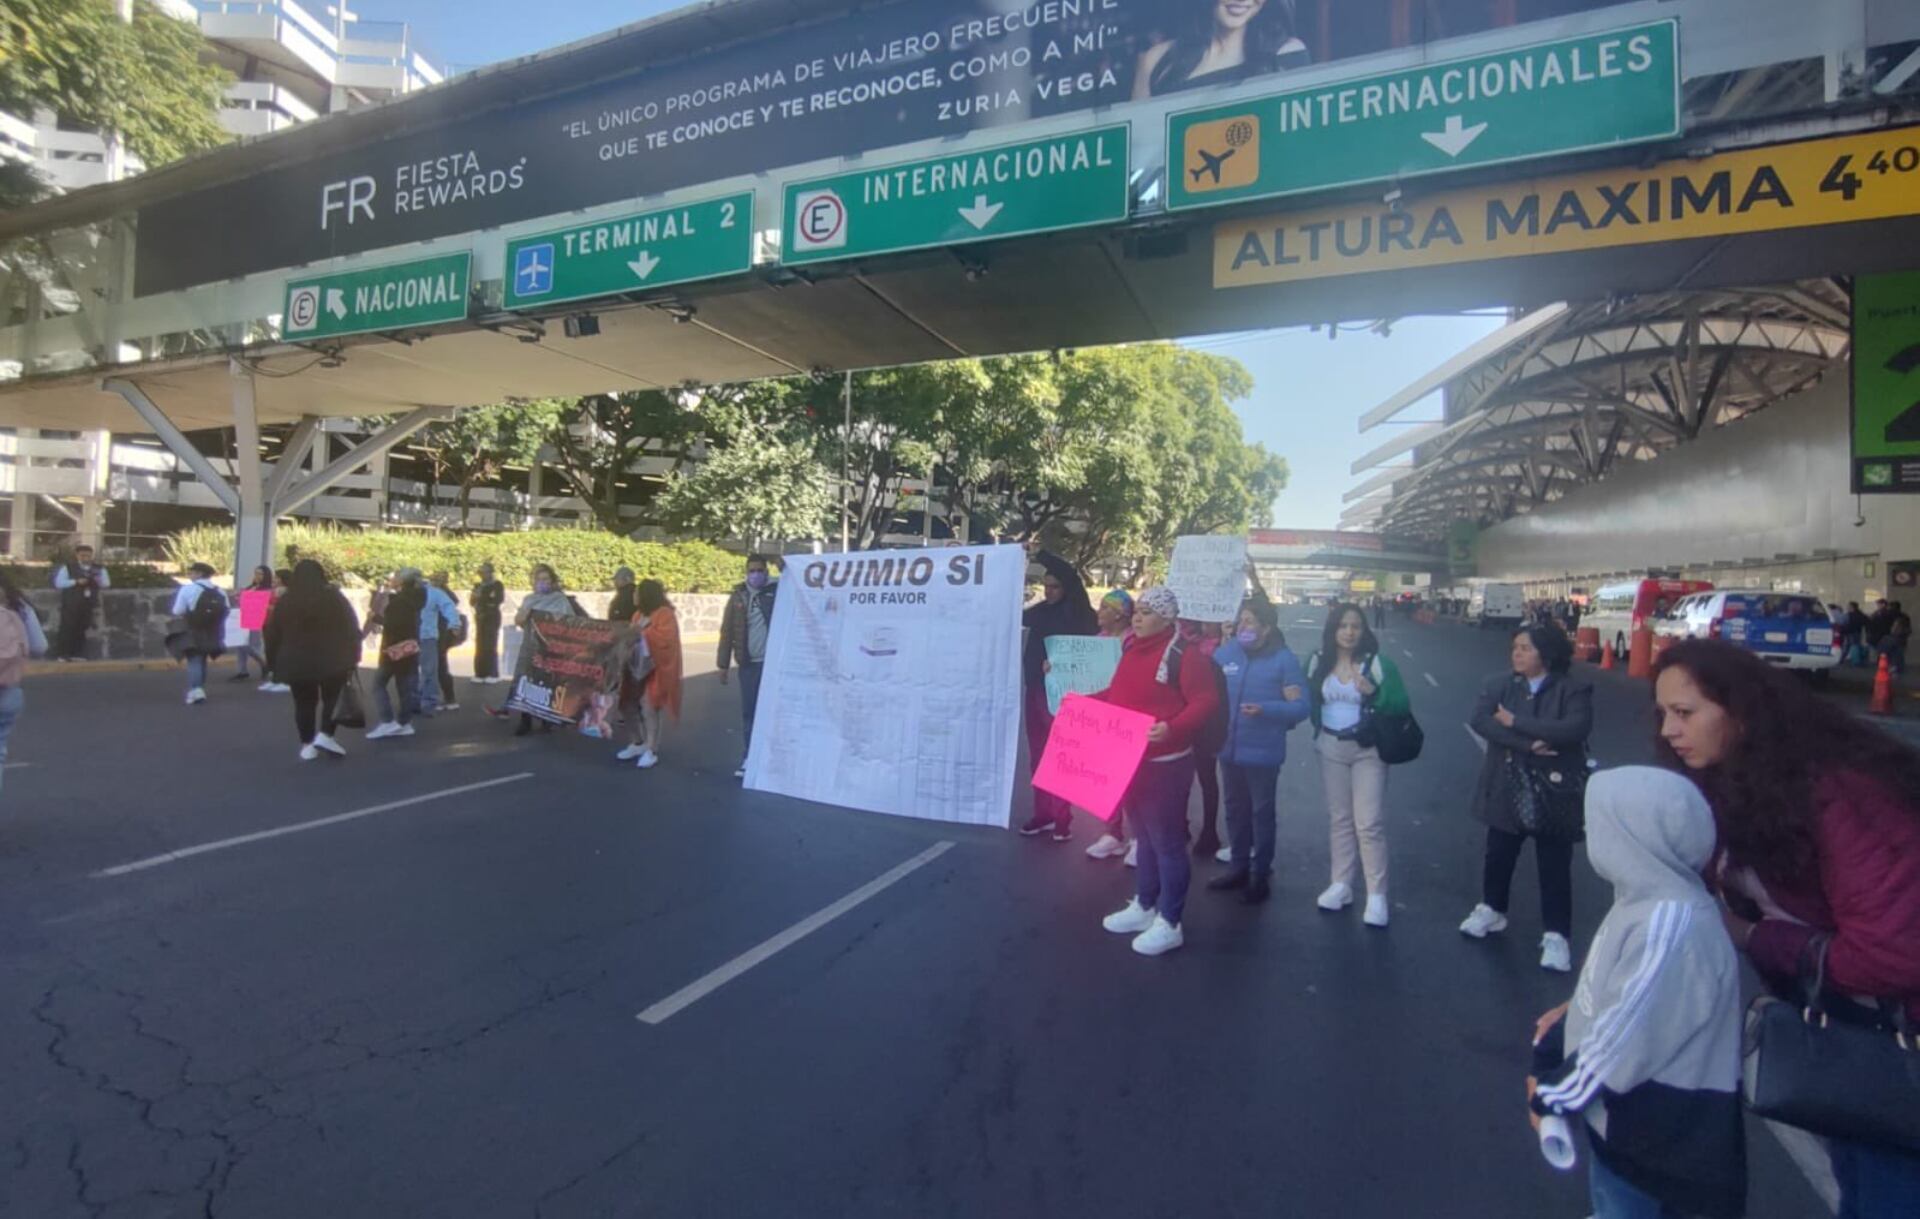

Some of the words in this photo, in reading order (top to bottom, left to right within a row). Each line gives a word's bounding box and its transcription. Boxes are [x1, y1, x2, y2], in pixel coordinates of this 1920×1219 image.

[597, 103, 659, 132] ÚNICO
[665, 70, 787, 115] PROGRAMA
[794, 58, 825, 83] DE
[833, 31, 941, 72] VIAJERO
[598, 138, 639, 161] QUE
[645, 130, 669, 151] TE
[672, 109, 755, 145] CONOCE
[760, 104, 774, 124] Y
[779, 98, 805, 119] TE
[810, 68, 942, 112] RECONOCE,
[949, 47, 1032, 82] COMO
[1042, 41, 1063, 62] A
[937, 89, 1022, 121] ZURIA
[1037, 68, 1118, 99] VEGA
[1279, 34, 1653, 134] INTERNACIONALES
[396, 150, 480, 189] FIESTA
[863, 136, 1112, 203] INTERNACIONAL
[321, 175, 377, 230] FR
[563, 210, 696, 258] TERMINAL
[720, 202, 735, 229] 2
[811, 203, 831, 235] E
[1231, 204, 1463, 271] ALTURA
[1486, 164, 1795, 242] MAXIMA
[355, 272, 460, 315] NACIONAL
[803, 556, 934, 590] QUIMIO
[849, 592, 876, 605] POR
[880, 592, 927, 605] FAVOR
